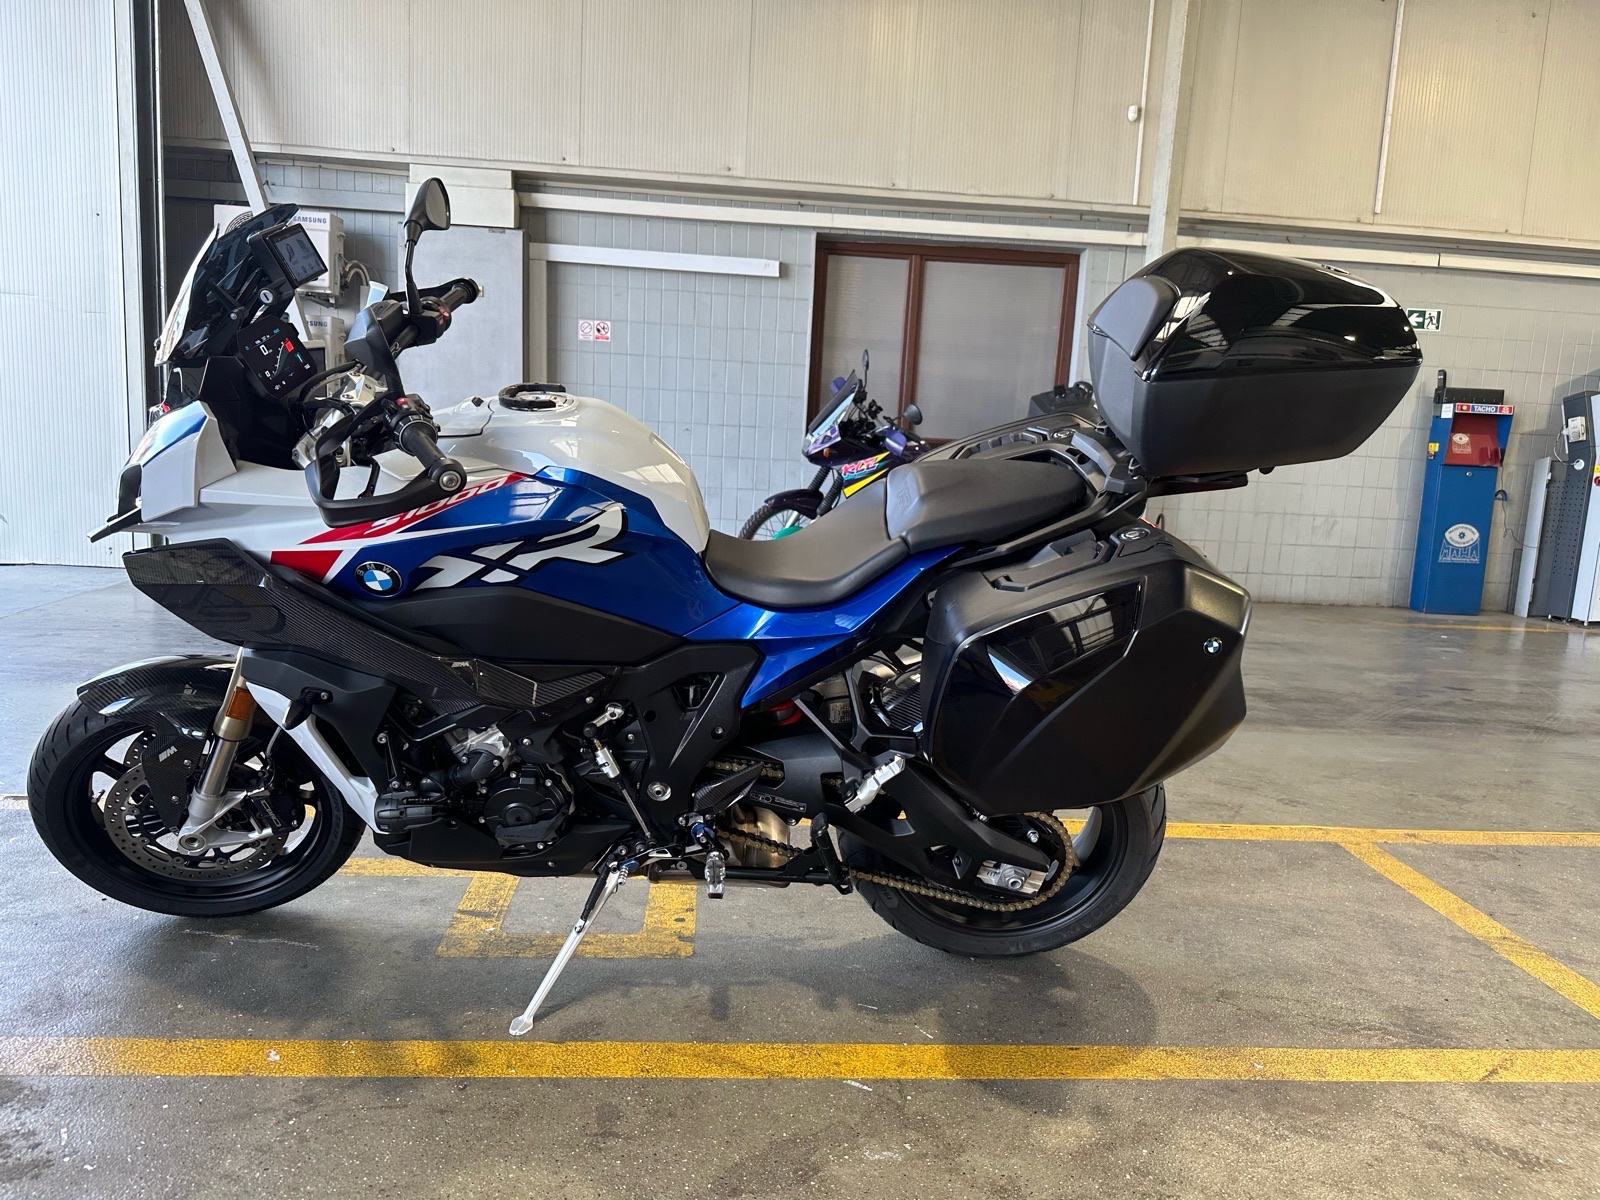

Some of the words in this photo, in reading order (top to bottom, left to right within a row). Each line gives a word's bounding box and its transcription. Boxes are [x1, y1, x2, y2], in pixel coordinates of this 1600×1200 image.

[292, 215, 327, 224] SAMSUNG
[1473, 405, 1496, 413] TACHO
[1441, 548, 1478, 559] MAHA
